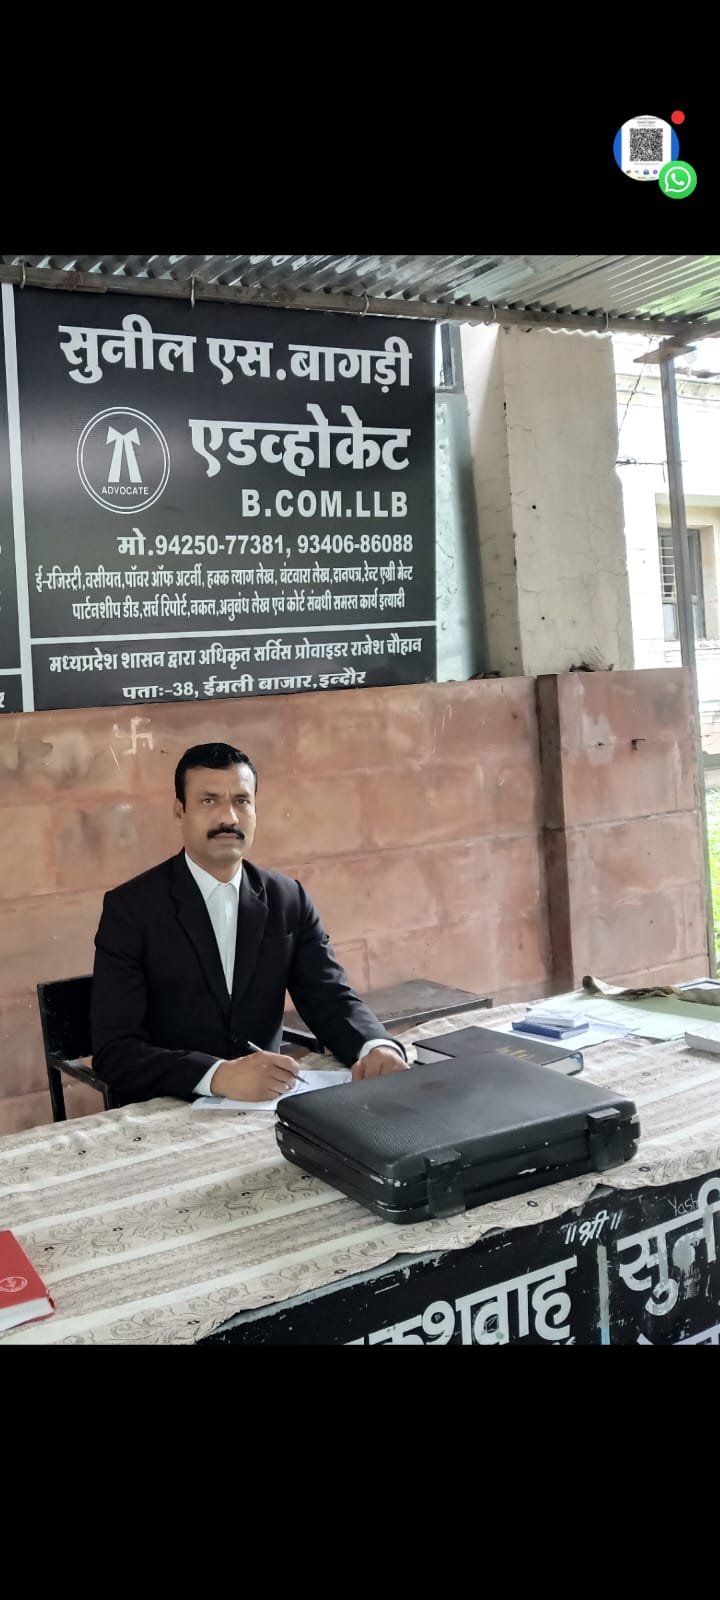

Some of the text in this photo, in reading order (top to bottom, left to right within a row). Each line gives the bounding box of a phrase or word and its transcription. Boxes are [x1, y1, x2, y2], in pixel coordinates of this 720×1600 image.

[58, 313, 412, 393] सुनील एस.बागड़ी
[188, 403, 412, 478] एडव्होकेट
[101, 485, 150, 496] ADVOCATE
[241, 489, 409, 519] B.COM.LLB
[297, 533, 414, 555] 93406-86088
[151, 564, 174, 588] ऑफ
[176, 562, 205, 588] अटर्नी,
[206, 569, 229, 589] हक्क
[231, 569, 254, 585] त्याग
[256, 561, 278, 587] लेख,
[72, 595, 121, 621] पार्टनशीप
[251, 590, 270, 614] लेख
[271, 590, 285, 616] एवं
[286, 589, 305, 612] कोर्ट
[333, 594, 358, 610] समस्त
[359, 587, 378, 609] कार्य
[378, 586, 406, 611] इत्यादी
[48, 632, 423, 672] मध्यप्रदेश शासन द्वारा अधिकृत सर्विस प्रोवाइडर राजेश चौहान
[202, 674, 255, 696] ईमली
